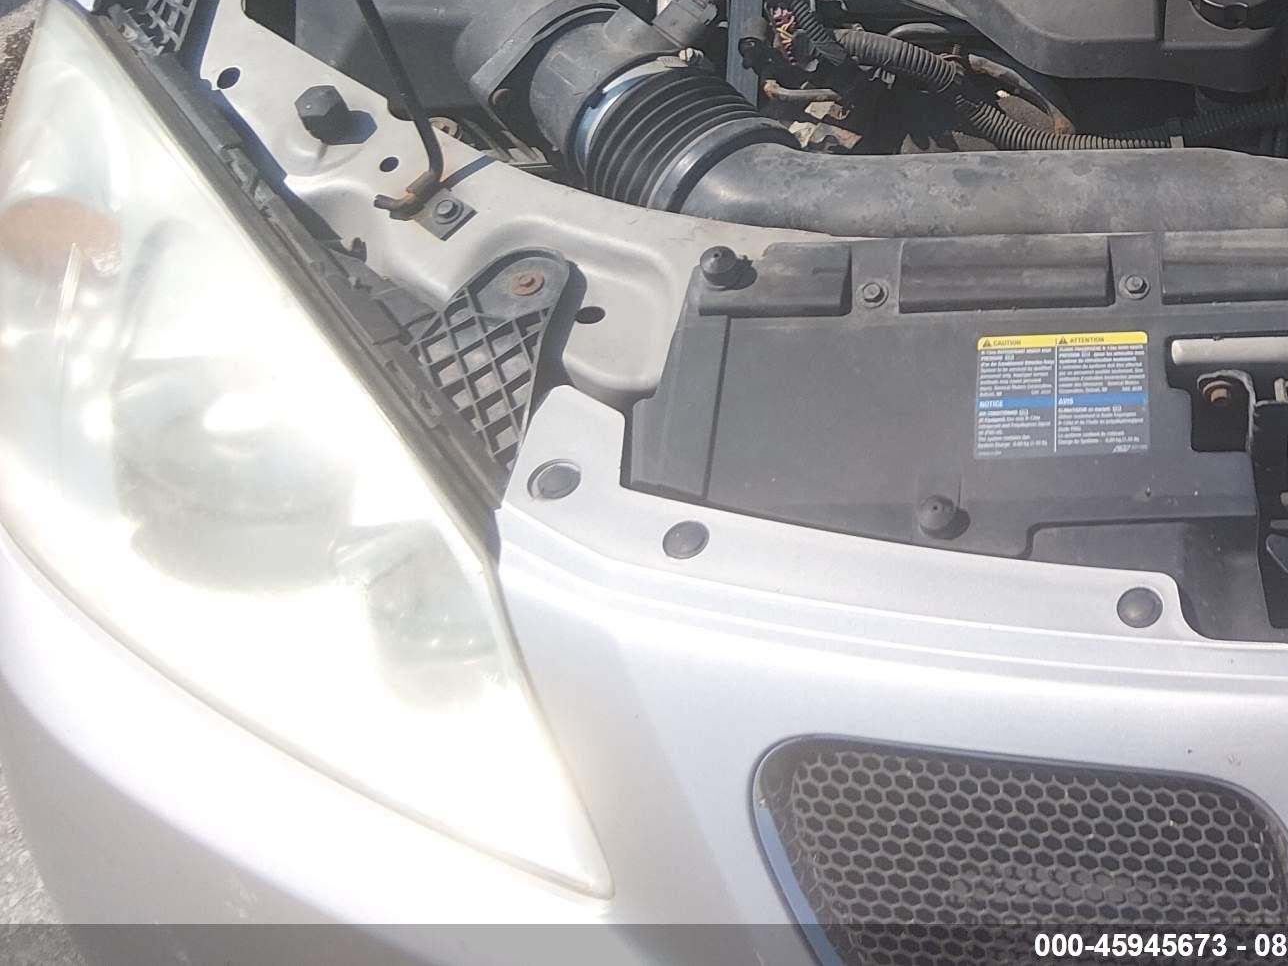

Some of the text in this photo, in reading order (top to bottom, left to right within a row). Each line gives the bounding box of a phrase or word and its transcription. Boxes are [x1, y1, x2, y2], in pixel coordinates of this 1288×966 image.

[993, 339, 1022, 347] CAUTION
[1069, 336, 1105, 344] ATTENTION
[979, 400, 1004, 409] NOTICE
[1058, 396, 1074, 405] AVIS
